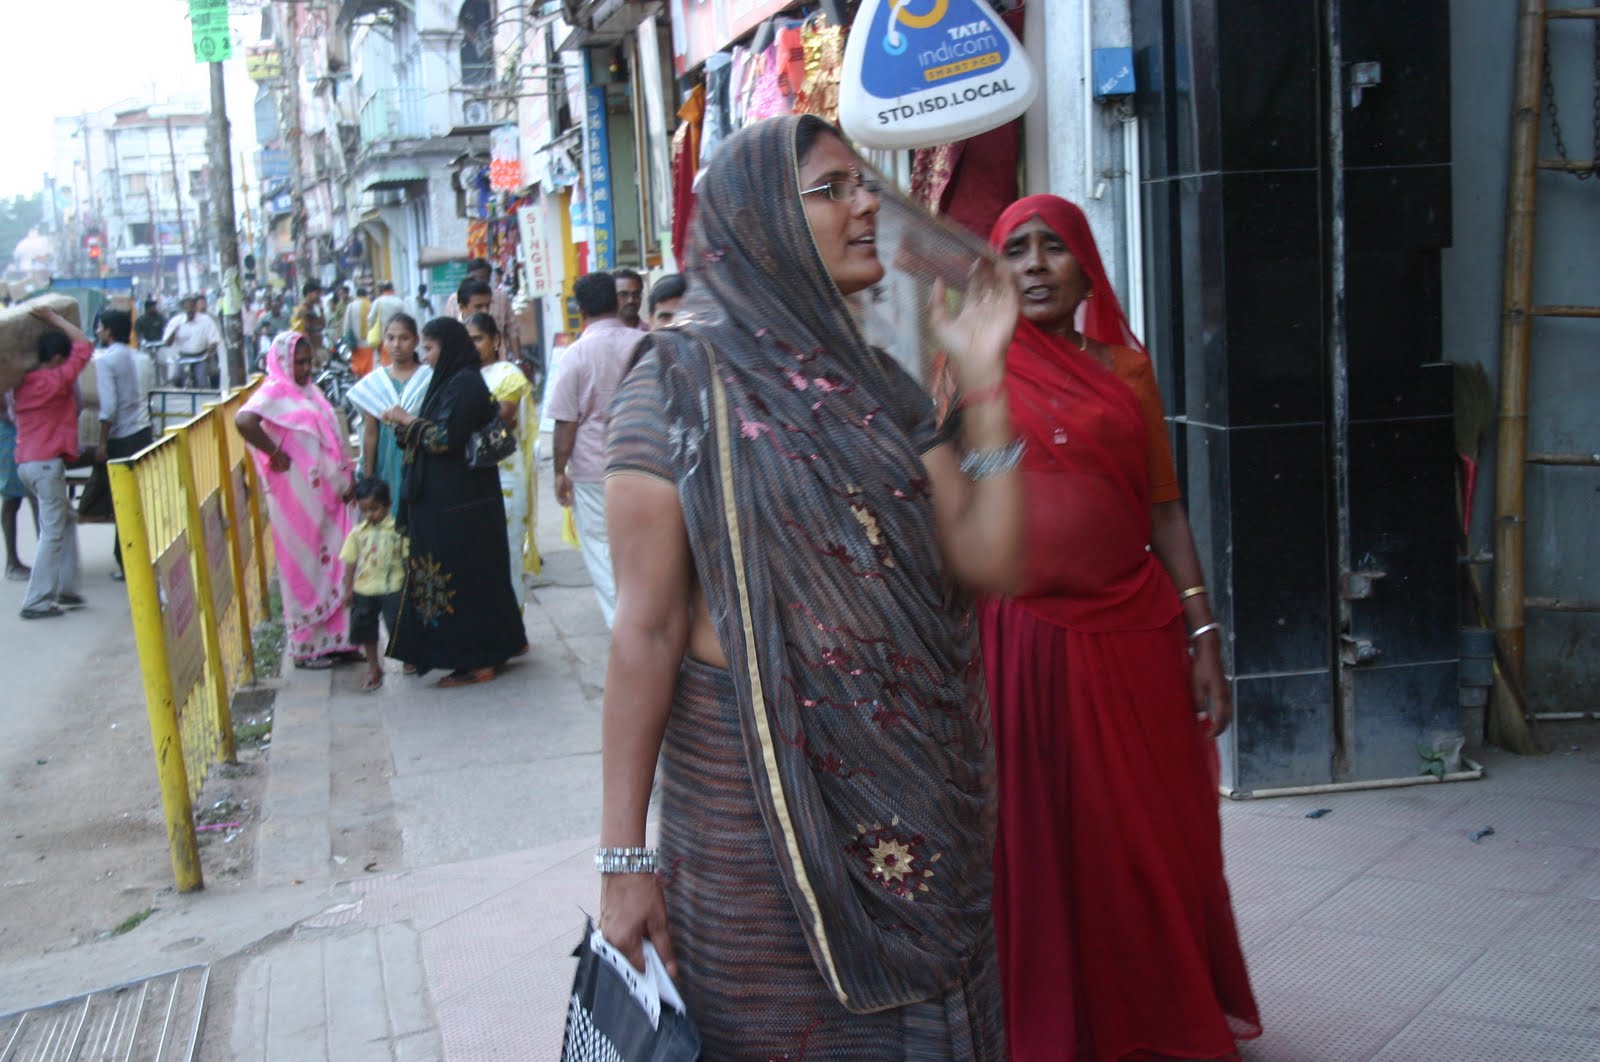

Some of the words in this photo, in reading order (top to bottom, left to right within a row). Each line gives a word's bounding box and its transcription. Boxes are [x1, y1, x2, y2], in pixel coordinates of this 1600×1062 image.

[947, 19, 992, 40] TATA
[918, 35, 997, 66] indicom
[878, 79, 1015, 124] STD.ISD.LOCAL
[526, 212, 545, 290] SINGER
